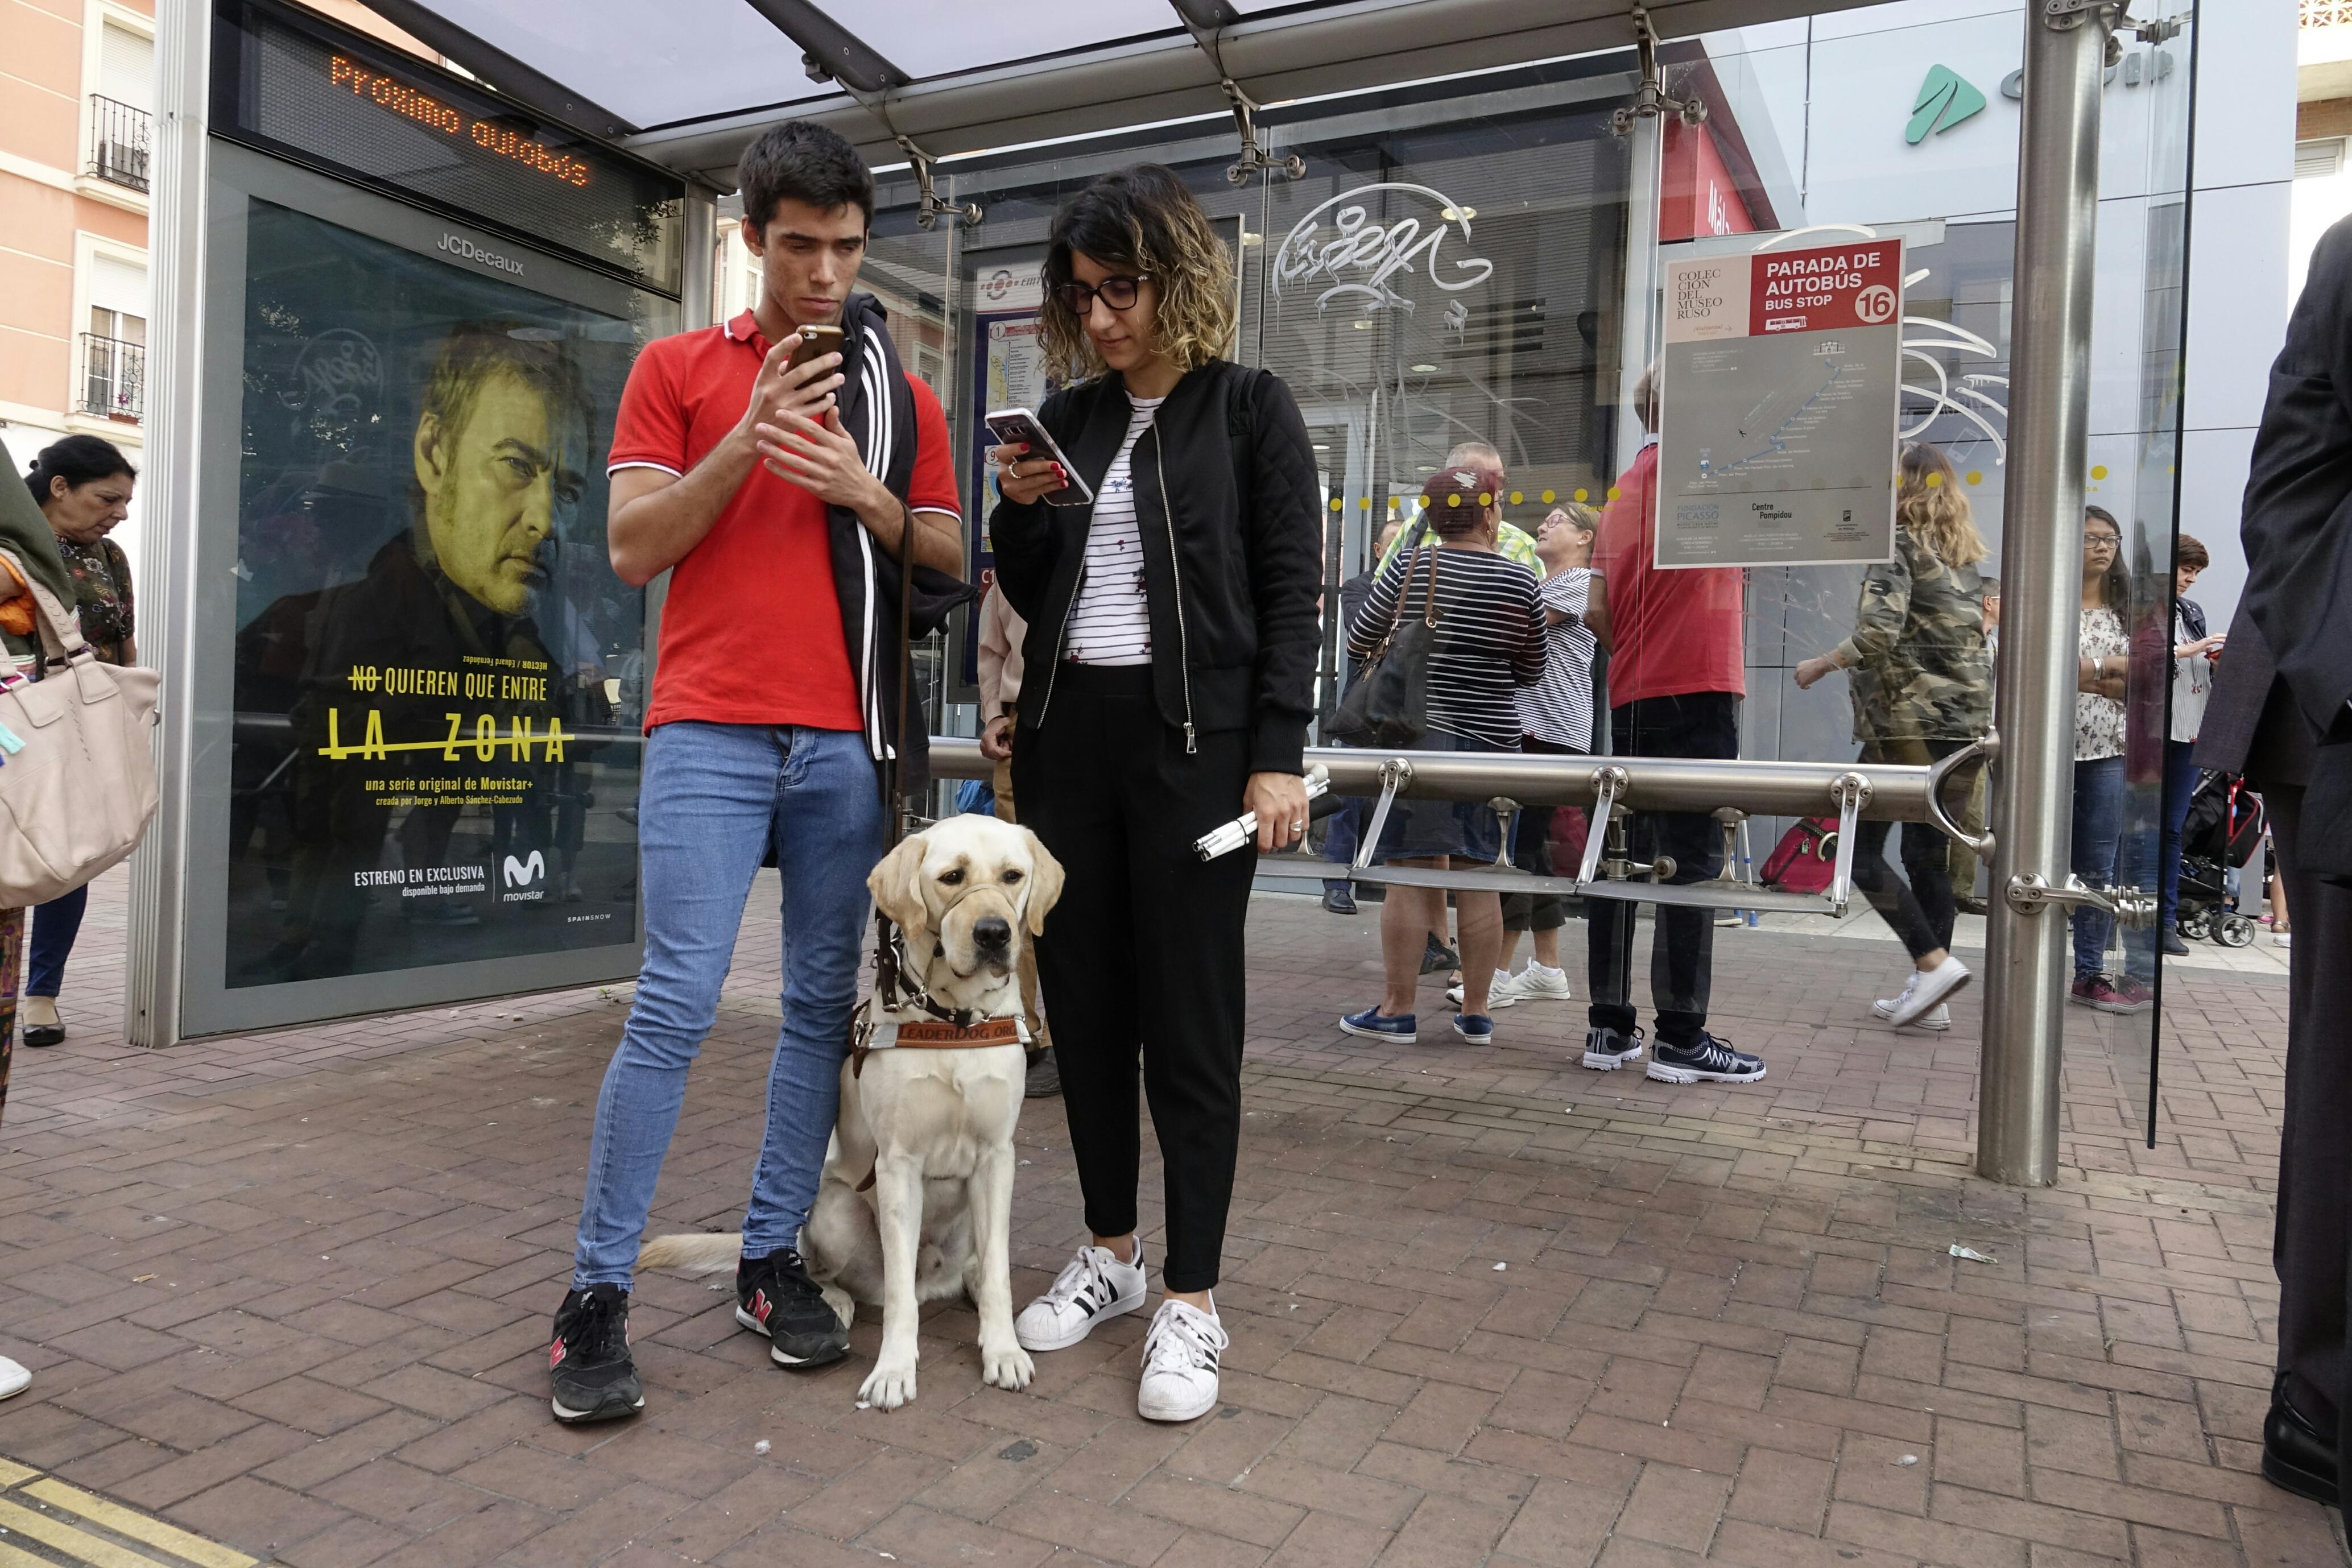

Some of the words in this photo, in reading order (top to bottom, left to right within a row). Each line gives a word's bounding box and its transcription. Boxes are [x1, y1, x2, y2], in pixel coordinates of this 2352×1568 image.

[333, 56, 459, 134] Próximo
[472, 122, 588, 187] autobús
[437, 233, 524, 277] JCDecaux
[1767, 256, 1848, 278] PARADA
[1854, 252, 1880, 269] DE
[1679, 269, 1721, 281] COLEC
[1766, 271, 1862, 296] AUTOBÚS
[1679, 290, 1702, 300] DEL
[1766, 299, 1792, 311] BUS
[1796, 295, 1832, 308] STOP
[1677, 297, 1722, 310] MUSEO
[1859, 292, 1890, 317] 16
[1677, 308, 1710, 319] RUSO
[990, 451, 995, 461] 9
[1677, 511, 1719, 520] PICASSO
[1760, 511, 1792, 520] Pompidou
[495, 659, 515, 668] Eduard
[352, 665, 377, 692] NO
[385, 668, 458, 696] QUIEREN
[465, 673, 494, 700] QUE
[502, 675, 547, 701] ENTRE
[329, 708, 386, 760] LA
[444, 713, 564, 763] ZONA
[365, 779, 385, 791] una
[388, 777, 415, 791] serie
[419, 777, 461, 793] original
[465, 777, 477, 791] de
[481, 777, 534, 791] Movistar+
[376, 796, 399, 805] creada
[400, 797, 412, 807] por
[414, 796, 432, 807] Jorge
[434, 797, 439, 806] y
[440, 796, 464, 805] Alberto
[466, 795, 523, 804] Sánchez-Cabezudo
[354, 870, 404, 886] ESTRENO
[410, 868, 423, 883] EN
[427, 866, 485, 882] EXCLUSIVA
[402, 884, 437, 898] disponible
[440, 884, 454, 895] bajo
[456, 882, 485, 893] demanda
[503, 891, 544, 902] movistar
